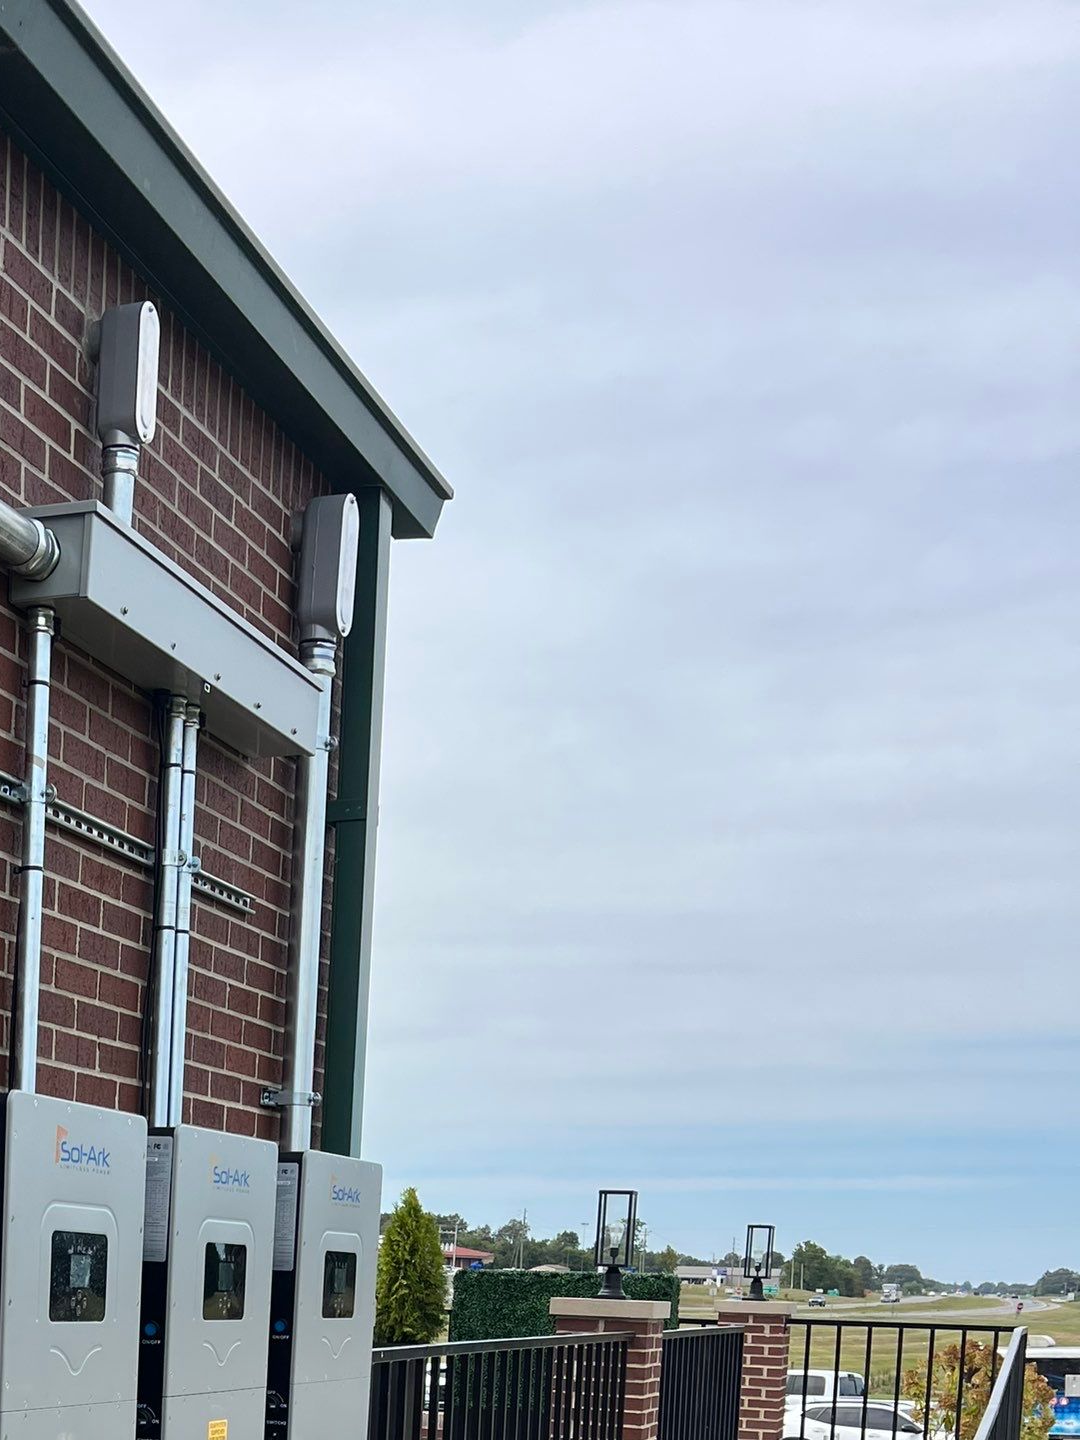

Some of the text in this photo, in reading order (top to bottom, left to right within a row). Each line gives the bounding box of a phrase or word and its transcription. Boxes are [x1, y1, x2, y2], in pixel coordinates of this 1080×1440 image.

[61, 1141, 111, 1168] Sol-Ark
[213, 1166, 250, 1188] Sol-Ark
[332, 1184, 362, 1204] Sol-Ark
